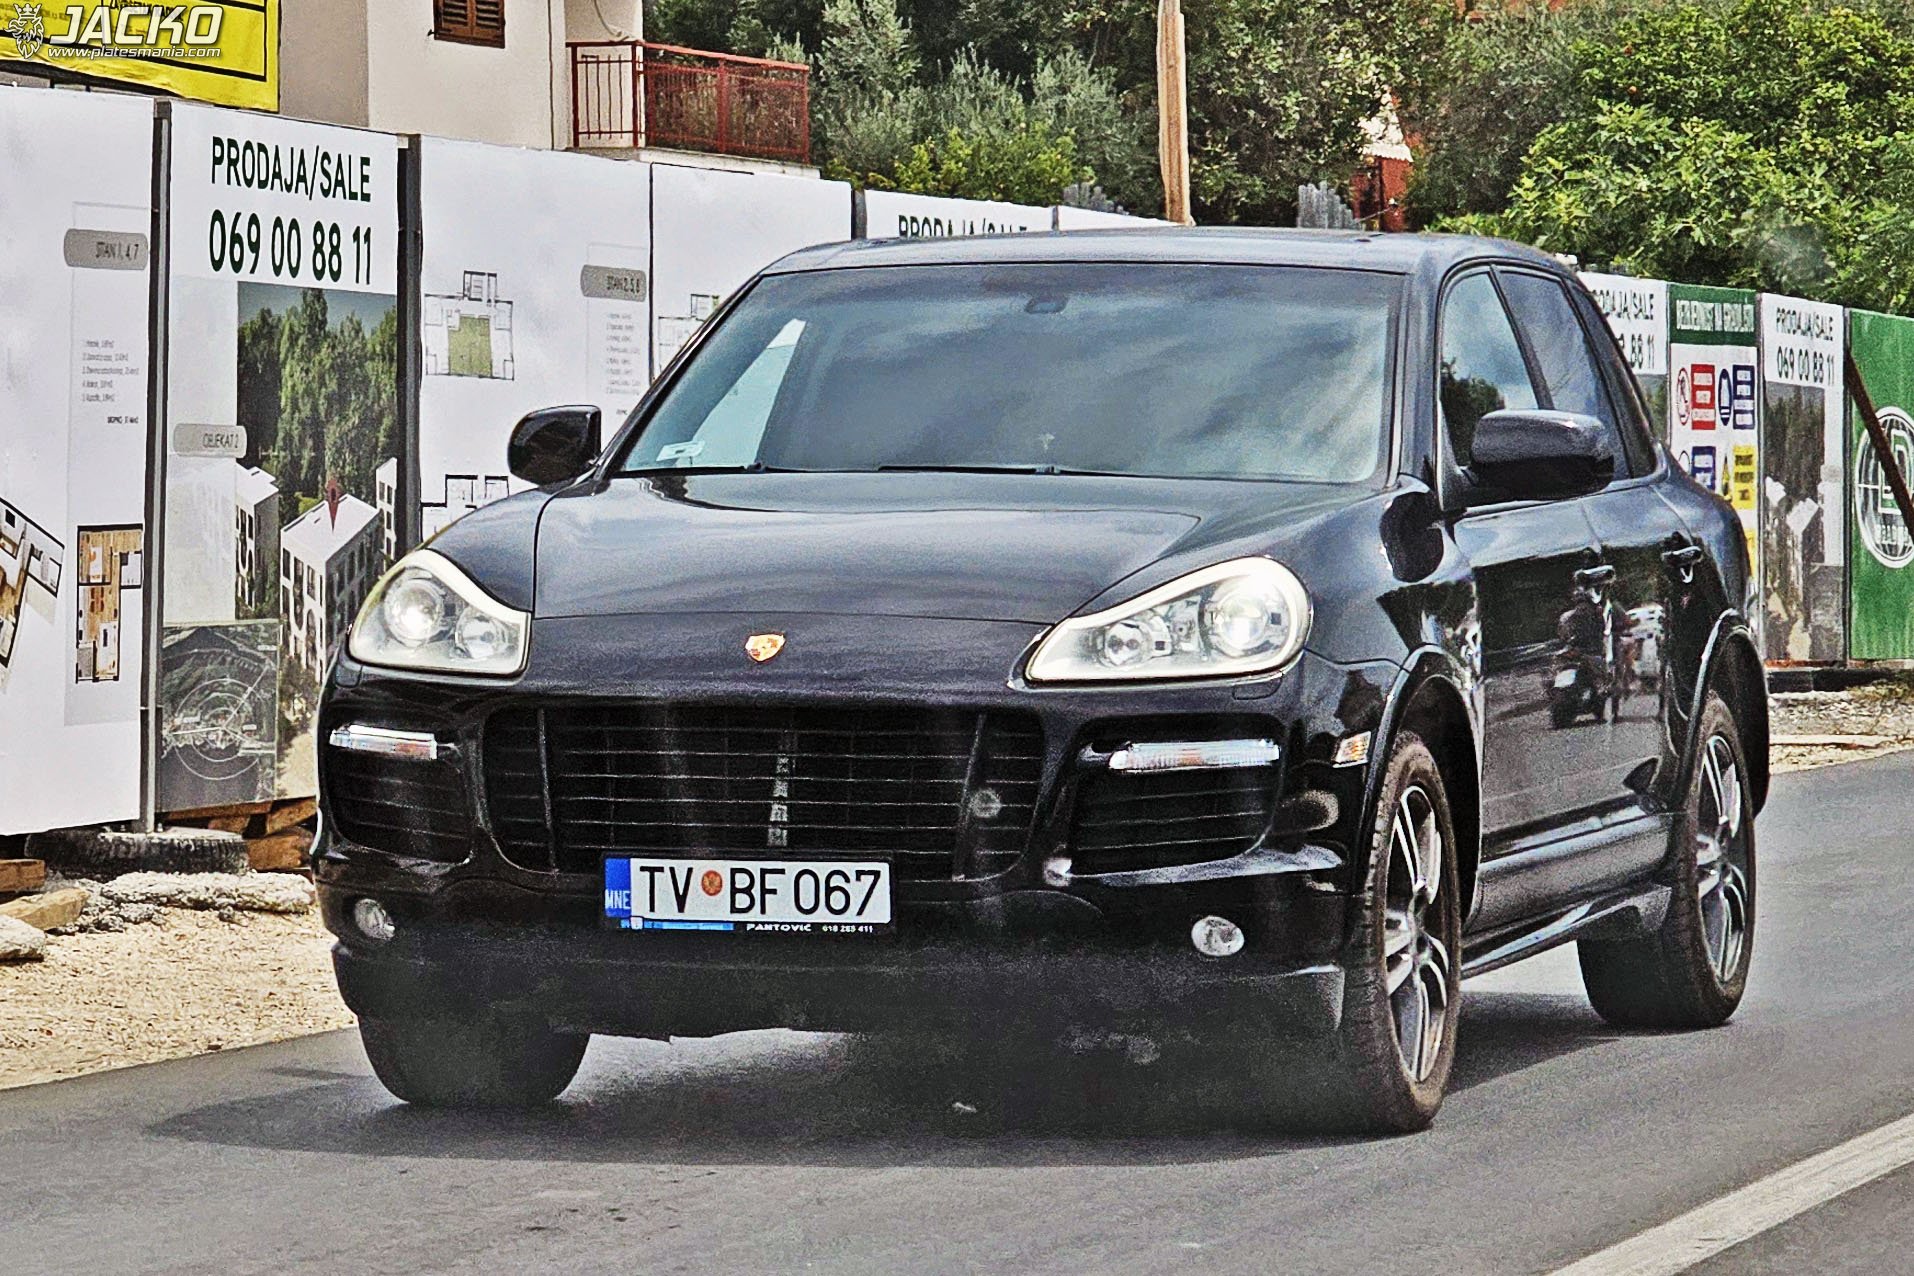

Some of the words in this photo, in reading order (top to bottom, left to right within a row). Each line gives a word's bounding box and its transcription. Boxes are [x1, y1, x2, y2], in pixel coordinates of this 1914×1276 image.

[211, 136, 371, 202] PRODAJA/SALE
[209, 209, 261, 273] 069
[271, 216, 301, 278] 00
[312, 220, 342, 282] 88
[352, 226, 371, 285] 11
[1776, 306, 1833, 341] PRODAJA/SALE
[1777, 346, 1794, 380] 069
[1798, 348, 1809, 381] 00
[1813, 350, 1824, 384] 88
[1827, 354, 1834, 387] 11
[605, 889, 631, 910] MNE
[640, 866, 693, 913] TV
